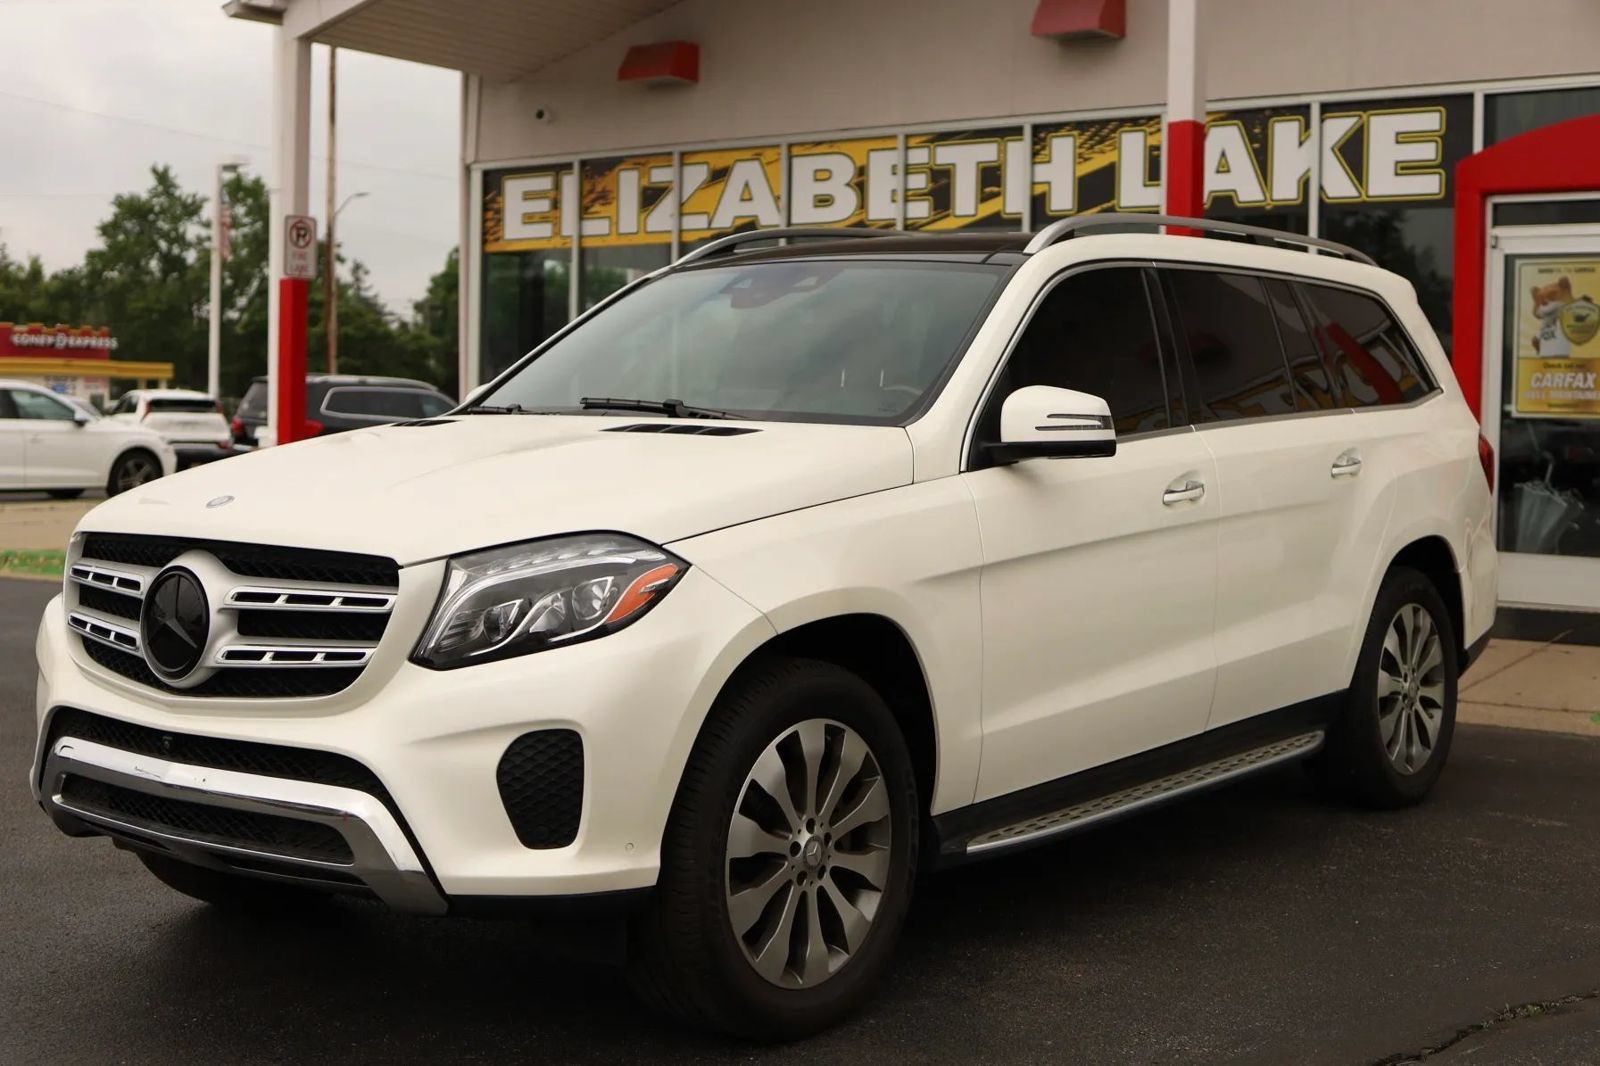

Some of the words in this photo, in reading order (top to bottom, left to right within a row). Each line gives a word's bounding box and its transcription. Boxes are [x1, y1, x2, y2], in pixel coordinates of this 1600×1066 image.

[502, 131, 1077, 242] ELIZABETH
[1116, 107, 1446, 213] LAKE
[1531, 371, 1597, 389] CARFAX
